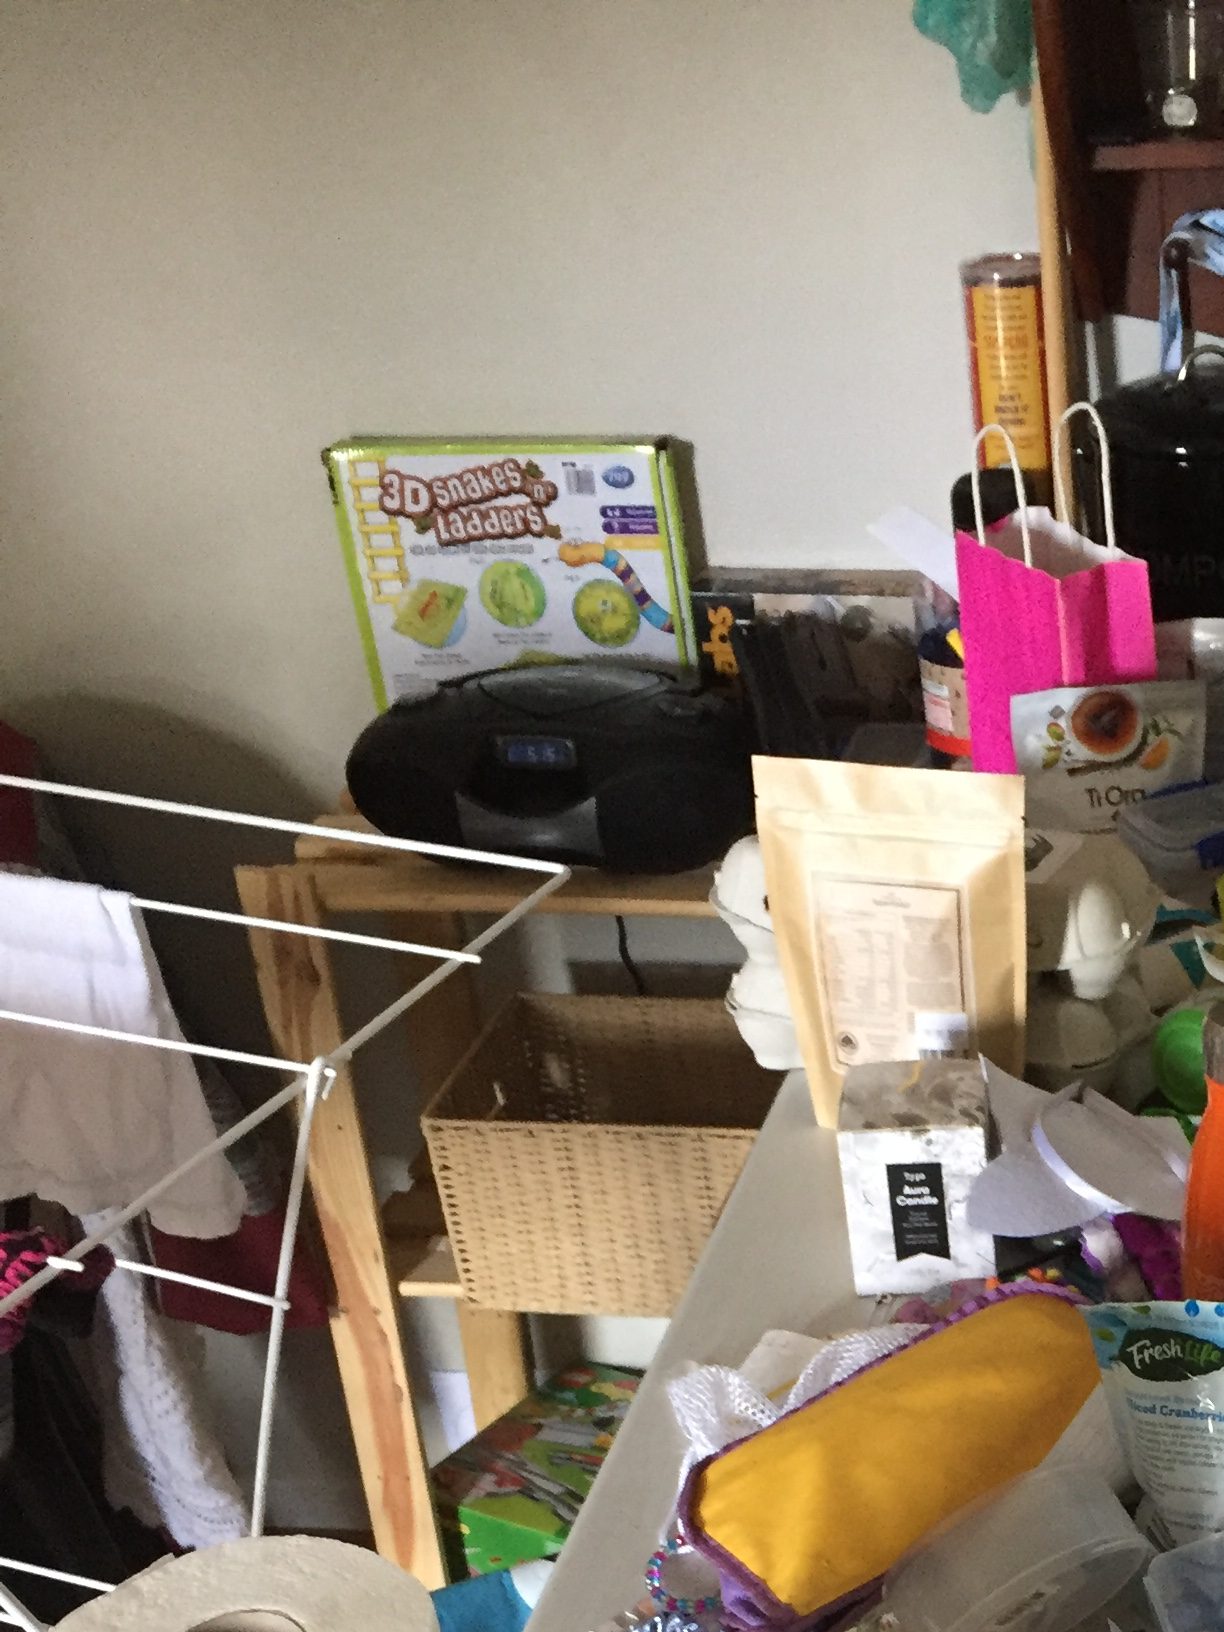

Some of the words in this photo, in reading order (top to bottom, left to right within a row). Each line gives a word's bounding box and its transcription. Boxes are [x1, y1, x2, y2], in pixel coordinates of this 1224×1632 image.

[896, 1195, 939, 1206] Candle
[1126, 1338, 1183, 1370] Fresh
[1185, 1341, 1222, 1368] Life
